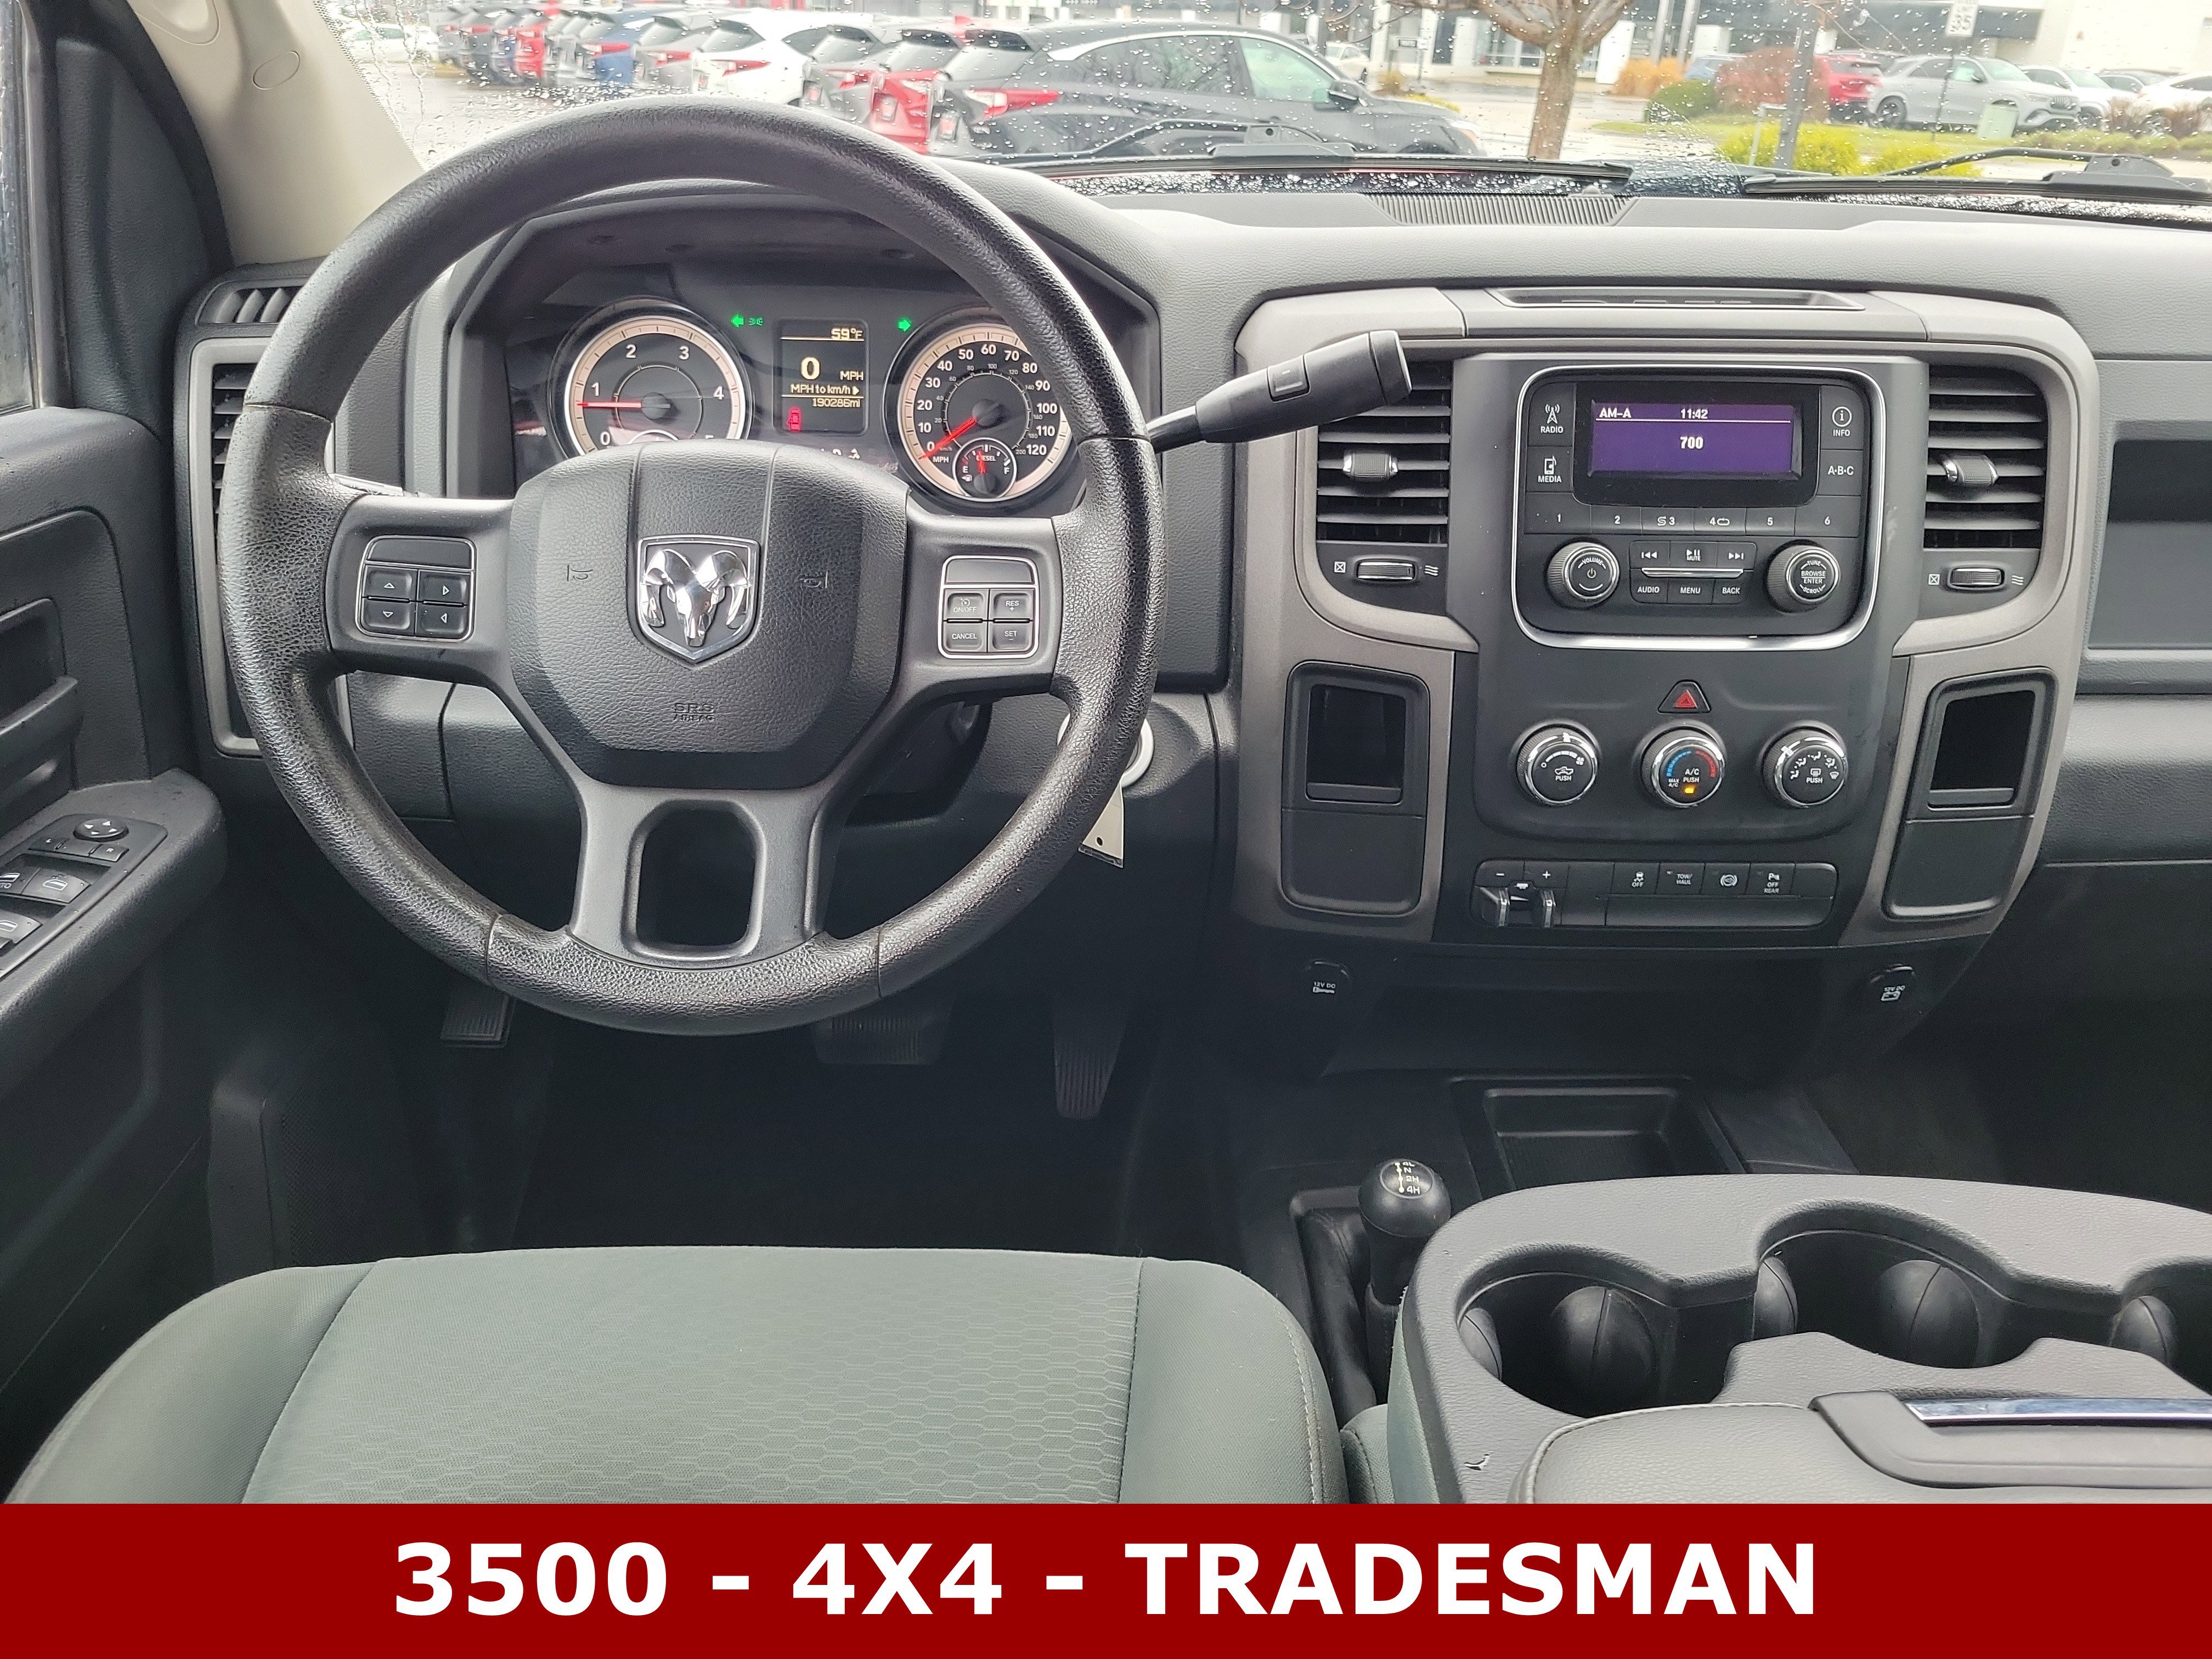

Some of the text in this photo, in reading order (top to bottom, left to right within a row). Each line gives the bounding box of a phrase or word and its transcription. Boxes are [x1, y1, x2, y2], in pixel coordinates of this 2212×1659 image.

[625, 344, 637, 359] 2
[679, 346, 690, 360] 3
[958, 349, 974, 360] 50
[980, 344, 996, 355] 60
[1003, 351, 1020, 361] 70
[800, 357, 864, 381] 0 MPH
[937, 360, 953, 371] 40
[1022, 363, 1037, 374] 80
[925, 377, 941, 388] 30
[1035, 380, 1051, 391] 90
[591, 382, 600, 396] 1
[713, 386, 724, 400] 4
[791, 384, 851, 394] MPH to km/h
[812, 398, 861, 408] 190286mi
[917, 399, 933, 410] 20
[1036, 402, 1058, 414] 100
[1599, 408, 1632, 418] AM-A
[1680, 408, 1708, 419] 11:42
[918, 422, 932, 432] 10
[1036, 426, 1056, 436] 110
[600, 431, 611, 445] 0
[1680, 436, 1704, 449] 700
[927, 442, 935, 452] 0
[1026, 444, 1047, 455] 120
[1557, 514, 1561, 523] 1
[1614, 516, 1621, 525] 2
[1669, 516, 1675, 526] 3
[1709, 517, 1716, 526] 4
[1767, 517, 1774, 526] 5
[1824, 516, 1831, 525] 6
[1582, 557, 1604, 565] VOLUME
[1407, 1186, 1420, 1194] 4H
